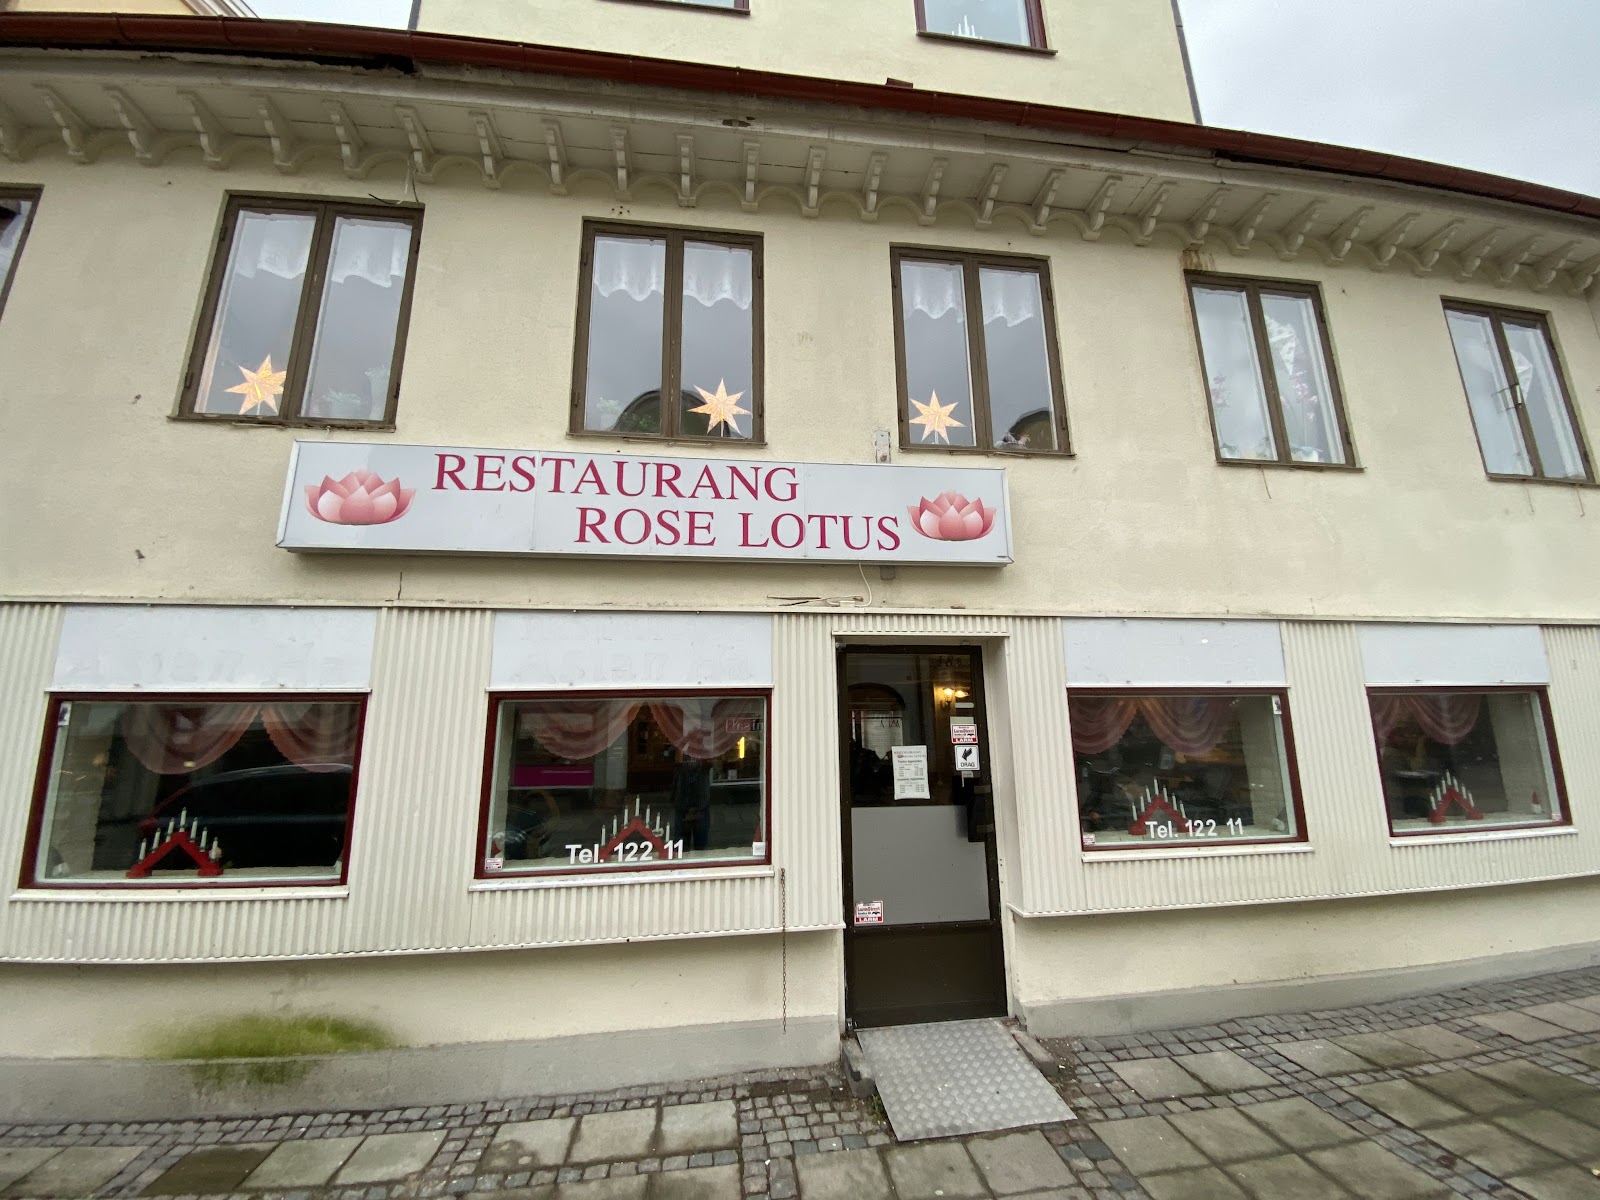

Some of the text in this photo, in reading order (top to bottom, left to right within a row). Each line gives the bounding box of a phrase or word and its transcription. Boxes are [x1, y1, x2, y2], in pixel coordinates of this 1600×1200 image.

[431, 453, 800, 502] RESTAURANG
[573, 506, 901, 552] ROSE LOTUS
[1145, 817, 1244, 839] Tel. 122 11
[565, 839, 684, 865] Tel. 122 11
